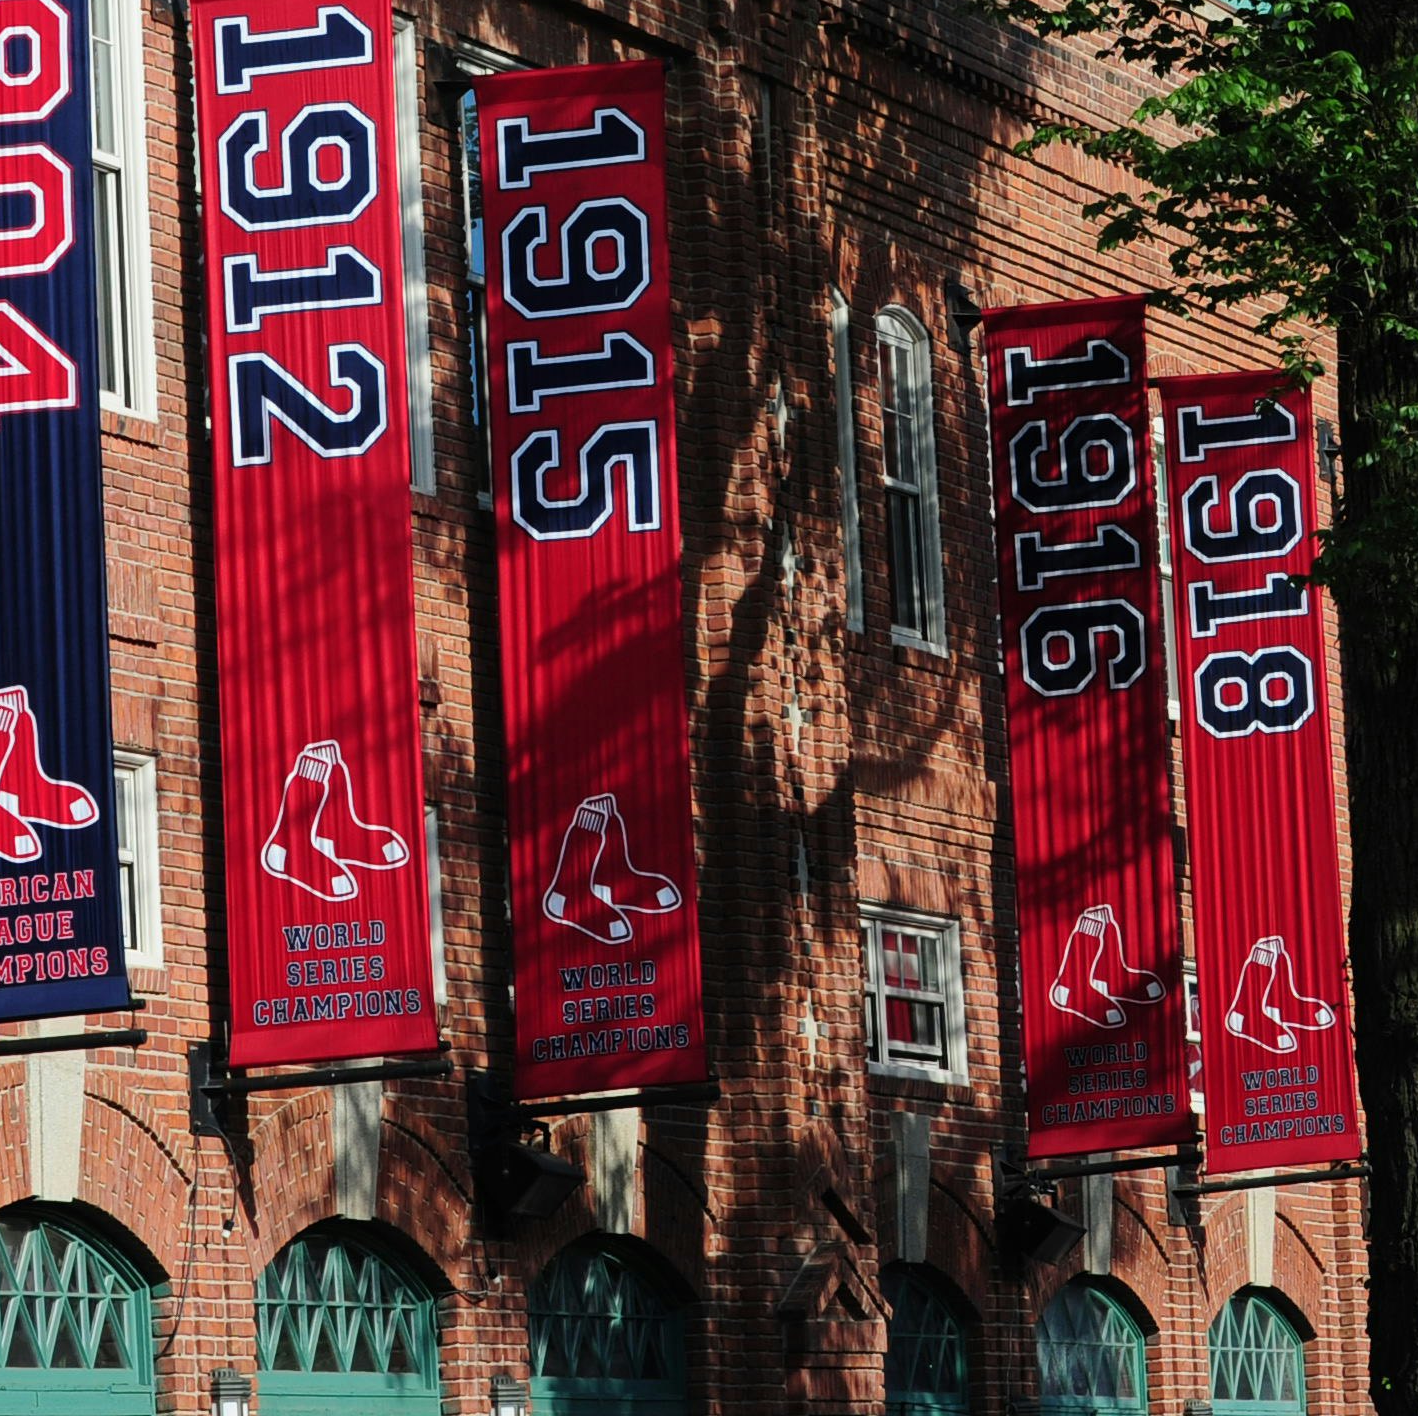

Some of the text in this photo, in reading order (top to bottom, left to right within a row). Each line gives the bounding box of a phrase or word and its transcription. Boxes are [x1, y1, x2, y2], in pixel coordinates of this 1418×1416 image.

[214, 5, 388, 468] 1912
[497, 107, 661, 541] 1915
[1004, 339, 1147, 697] 1916
[1177, 398, 1315, 739] 1918
[283, 920, 386, 953] WORLD
[287, 955, 384, 988] SERIES
[560, 960, 656, 992] WORLD
[253, 989, 422, 1026] CHAMPIONS
[563, 994, 656, 1025] SERIES
[533, 1024, 690, 1062] CHAMPIONS
[1065, 1041, 1148, 1068] WORLD
[1069, 1069, 1148, 1095] SERIES
[1242, 1065, 1319, 1091] WORLD
[1042, 1094, 1176, 1125] CHAMPIONS
[1245, 1091, 1318, 1117] SERIES
[1220, 1114, 1345, 1145] CHAMPIONS
